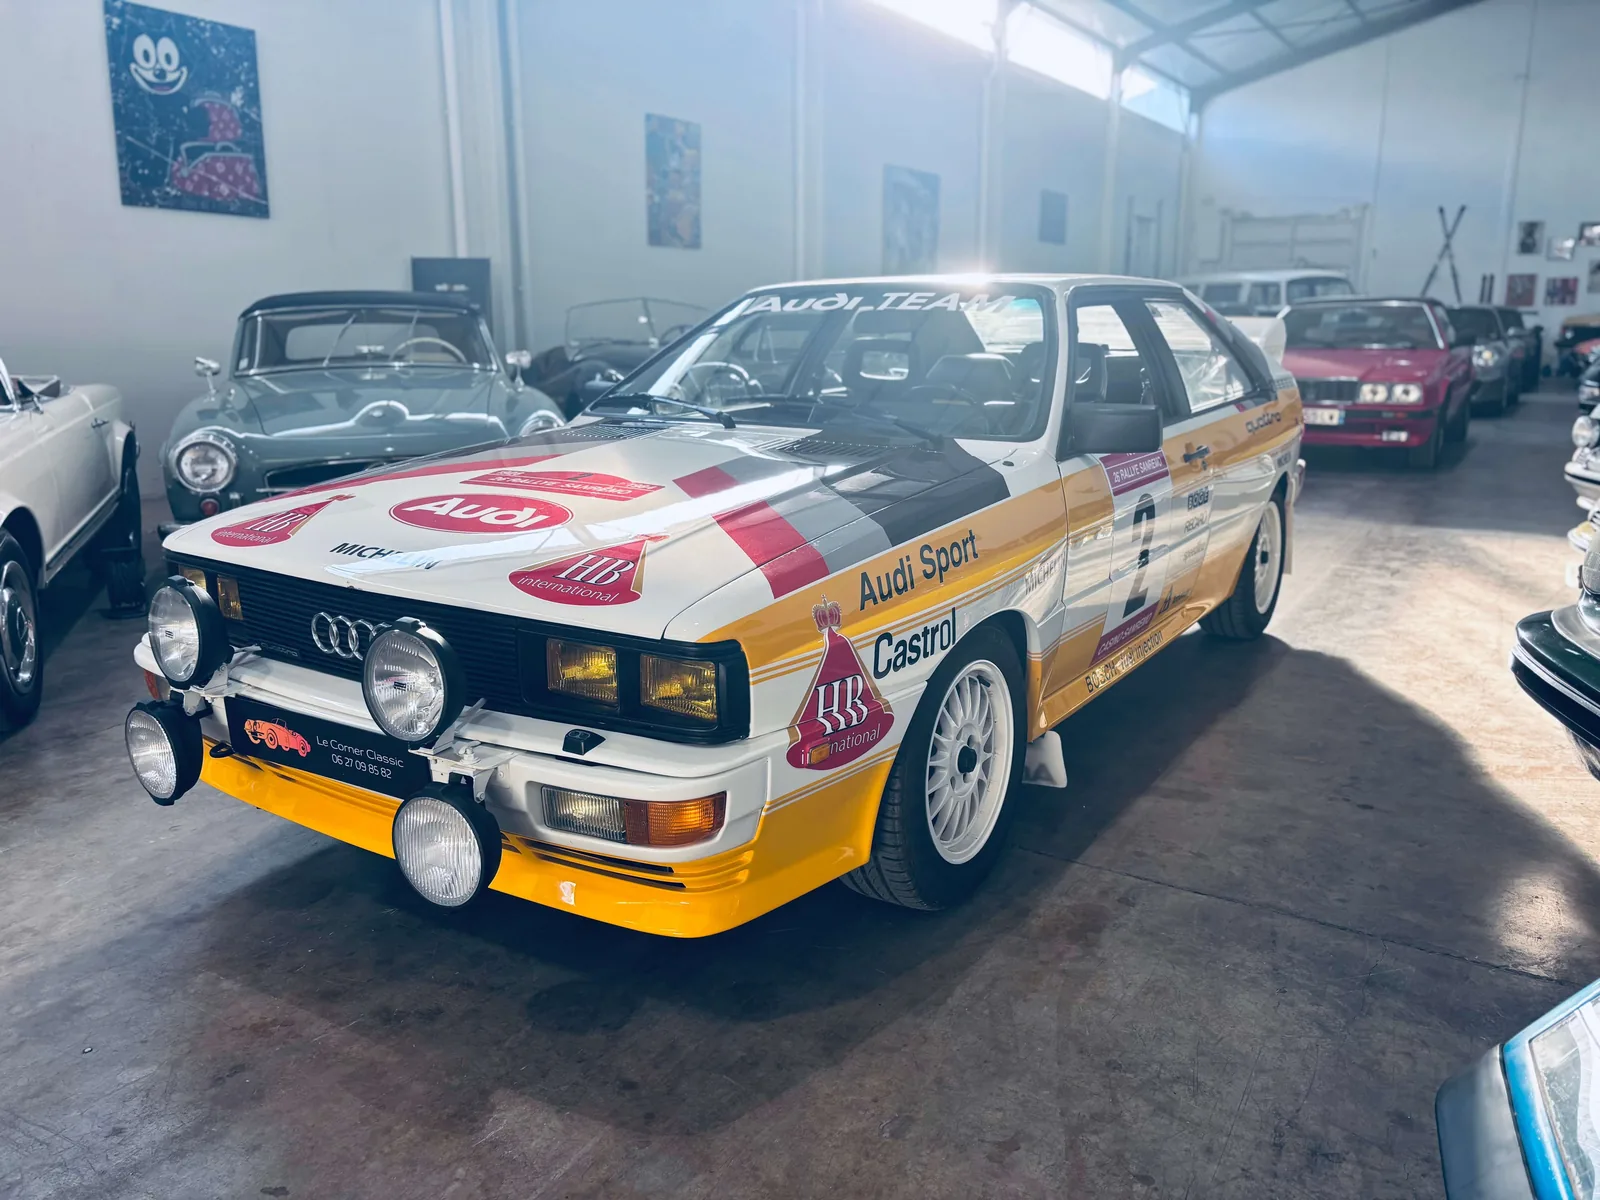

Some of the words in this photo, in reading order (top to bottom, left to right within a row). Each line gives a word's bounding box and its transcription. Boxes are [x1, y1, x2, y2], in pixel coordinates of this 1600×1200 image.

[876, 292, 1017, 313] TEAM
[1246, 411, 1281, 435] quattro
[505, 477, 561, 487] RALLYE
[560, 483, 632, 495] SANREMO
[567, 472, 594, 481] 2
[1113, 471, 1121, 483] 26
[1120, 463, 1140, 480] RALLYE
[243, 511, 309, 533] HB
[214, 529, 278, 543] international
[1122, 493, 1155, 618] 2
[552, 553, 635, 586] HB
[859, 554, 915, 611] Audi
[919, 529, 979, 584] Sport
[517, 576, 619, 602] international
[873, 606, 957, 680] Castrol
[1085, 661, 1118, 693] BOSCH
[1135, 630, 1164, 660] injection
[815, 674, 868, 737] HB
[316, 735, 329, 747] Le
[330, 739, 365, 757] Corner
[366, 749, 404, 768] Classic
[331, 753, 344, 765] 06
[344, 757, 354, 768] 27
[355, 760, 367, 772] 09
[368, 763, 380, 776] 85
[380, 767, 392, 779] 82
